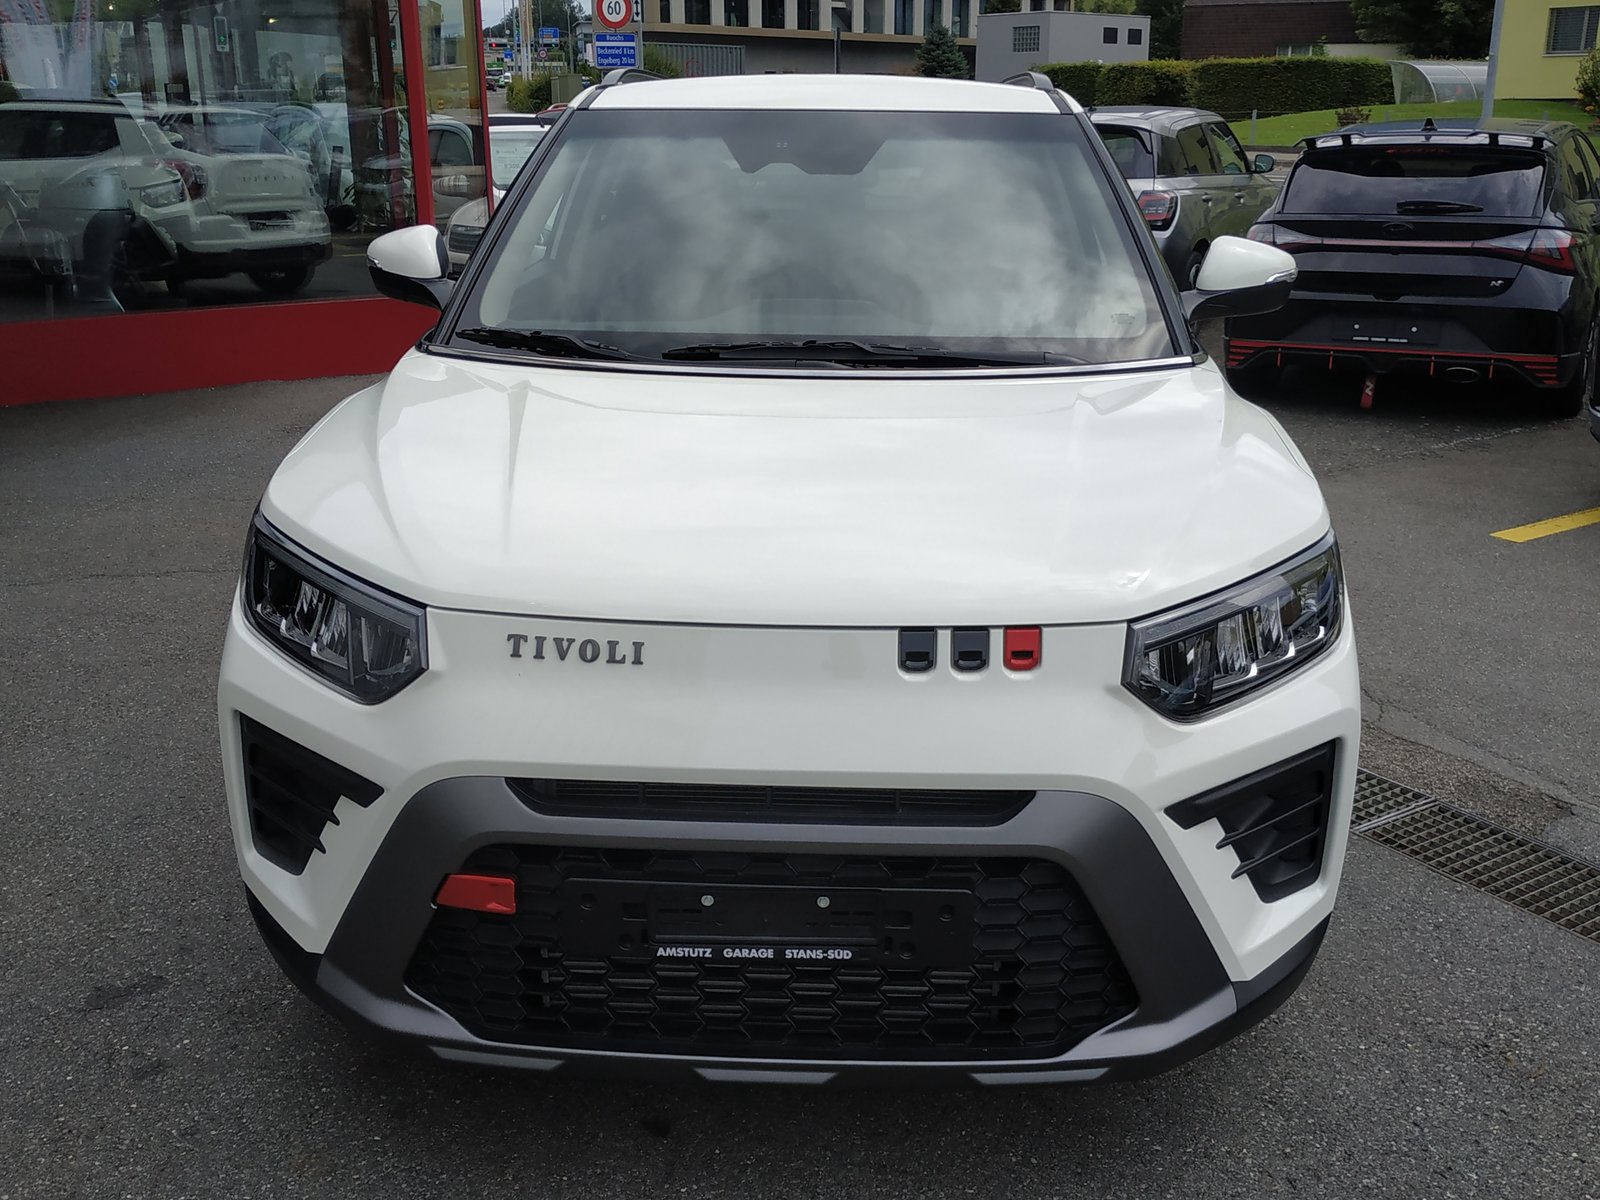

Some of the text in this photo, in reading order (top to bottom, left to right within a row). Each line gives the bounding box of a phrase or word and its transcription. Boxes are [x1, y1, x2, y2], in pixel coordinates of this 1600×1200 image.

[607, 1, 621, 15] 60
[598, 57, 620, 65] Engelberg
[506, 633, 645, 665] TIVOLI
[656, 947, 853, 960] AMSTUTZ GARAGE STANS-SÜD
